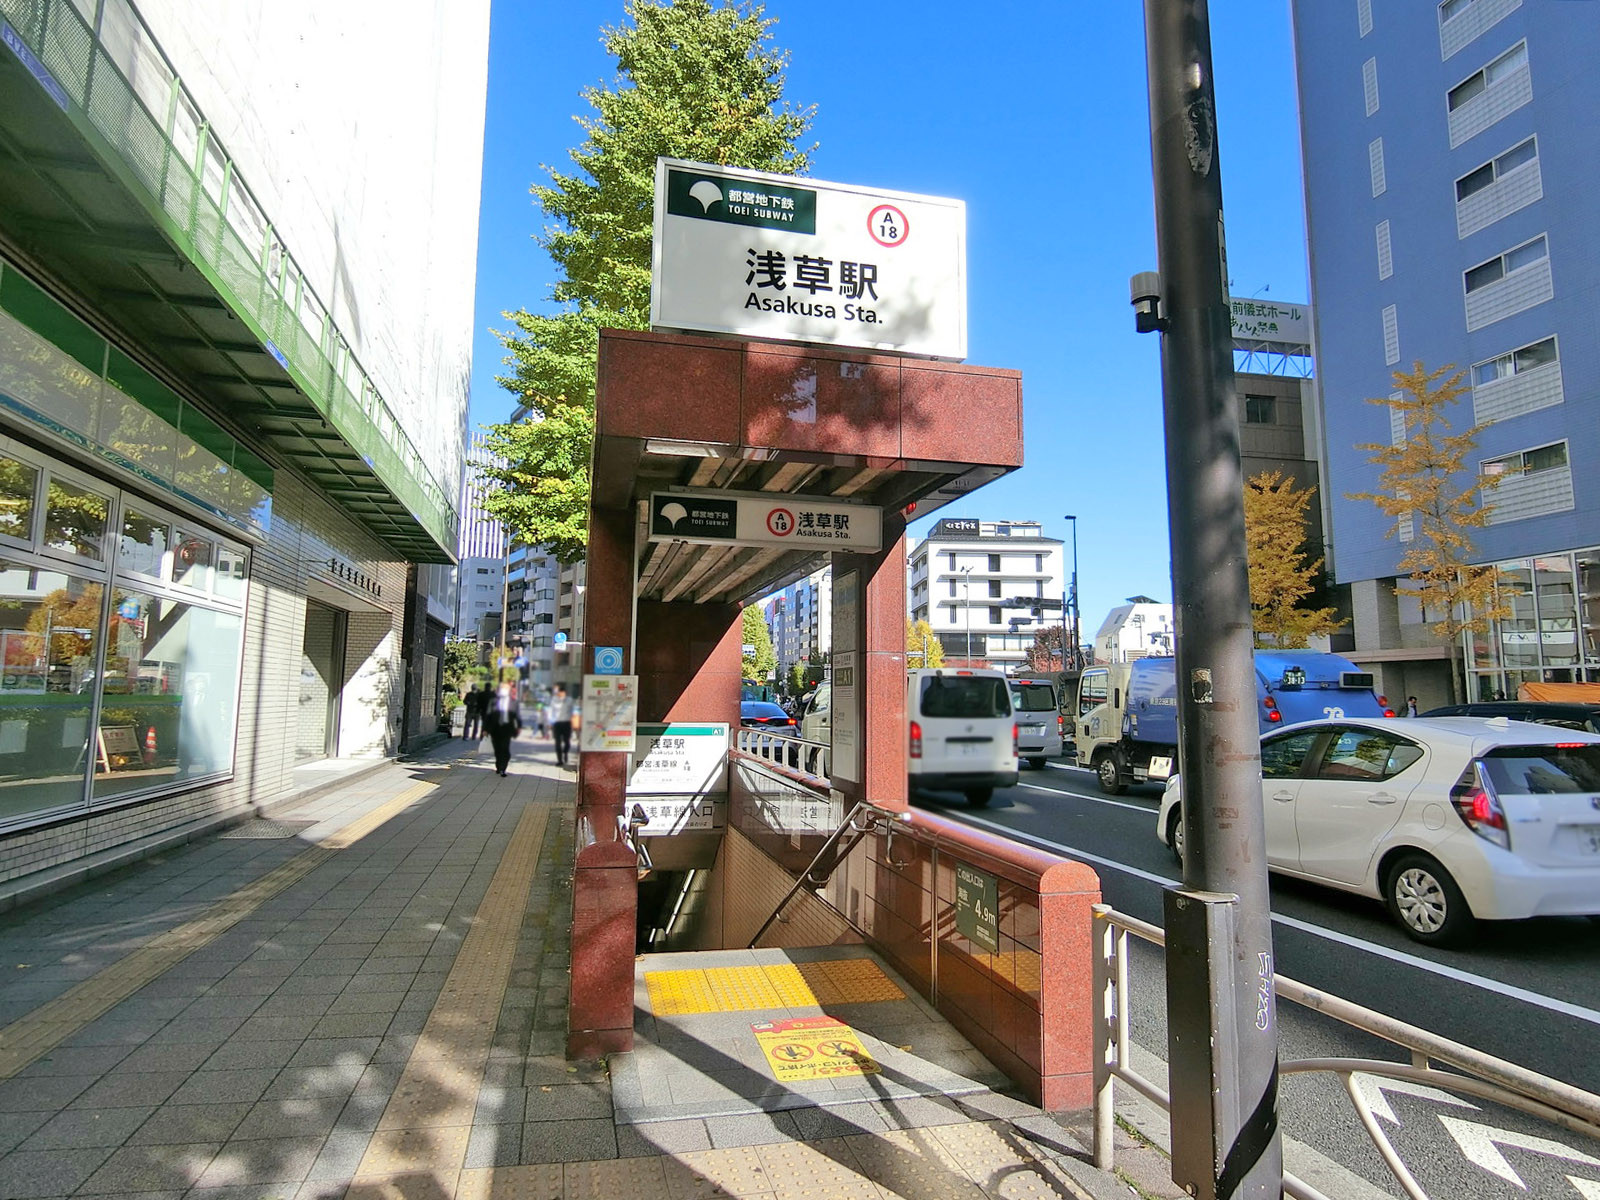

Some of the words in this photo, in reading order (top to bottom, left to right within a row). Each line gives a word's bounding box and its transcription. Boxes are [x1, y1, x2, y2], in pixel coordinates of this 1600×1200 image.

[728, 189, 795, 211] 都営地下鉄
[728, 204, 750, 217] TOEI
[753, 207, 794, 223] SUBWAY
[882, 212, 894, 224] A
[879, 225, 898, 239] 18
[745, 247, 879, 301] 浅草駅
[744, 292, 836, 320] Asakusa
[843, 303, 883, 325] Sta.
[1230, 301, 1301, 321] 前儀式ホール
[777, 513, 785, 521] A
[798, 511, 850, 531] 浅草駅
[775, 521, 787, 531] 18
[796, 529, 833, 538] Asakusa
[835, 531, 851, 540] Sta.
[650, 738, 685, 749] 浅草駅
[625, 805, 713, 819] 浅草線入口
[974, 899, 996, 927] 4.9m
